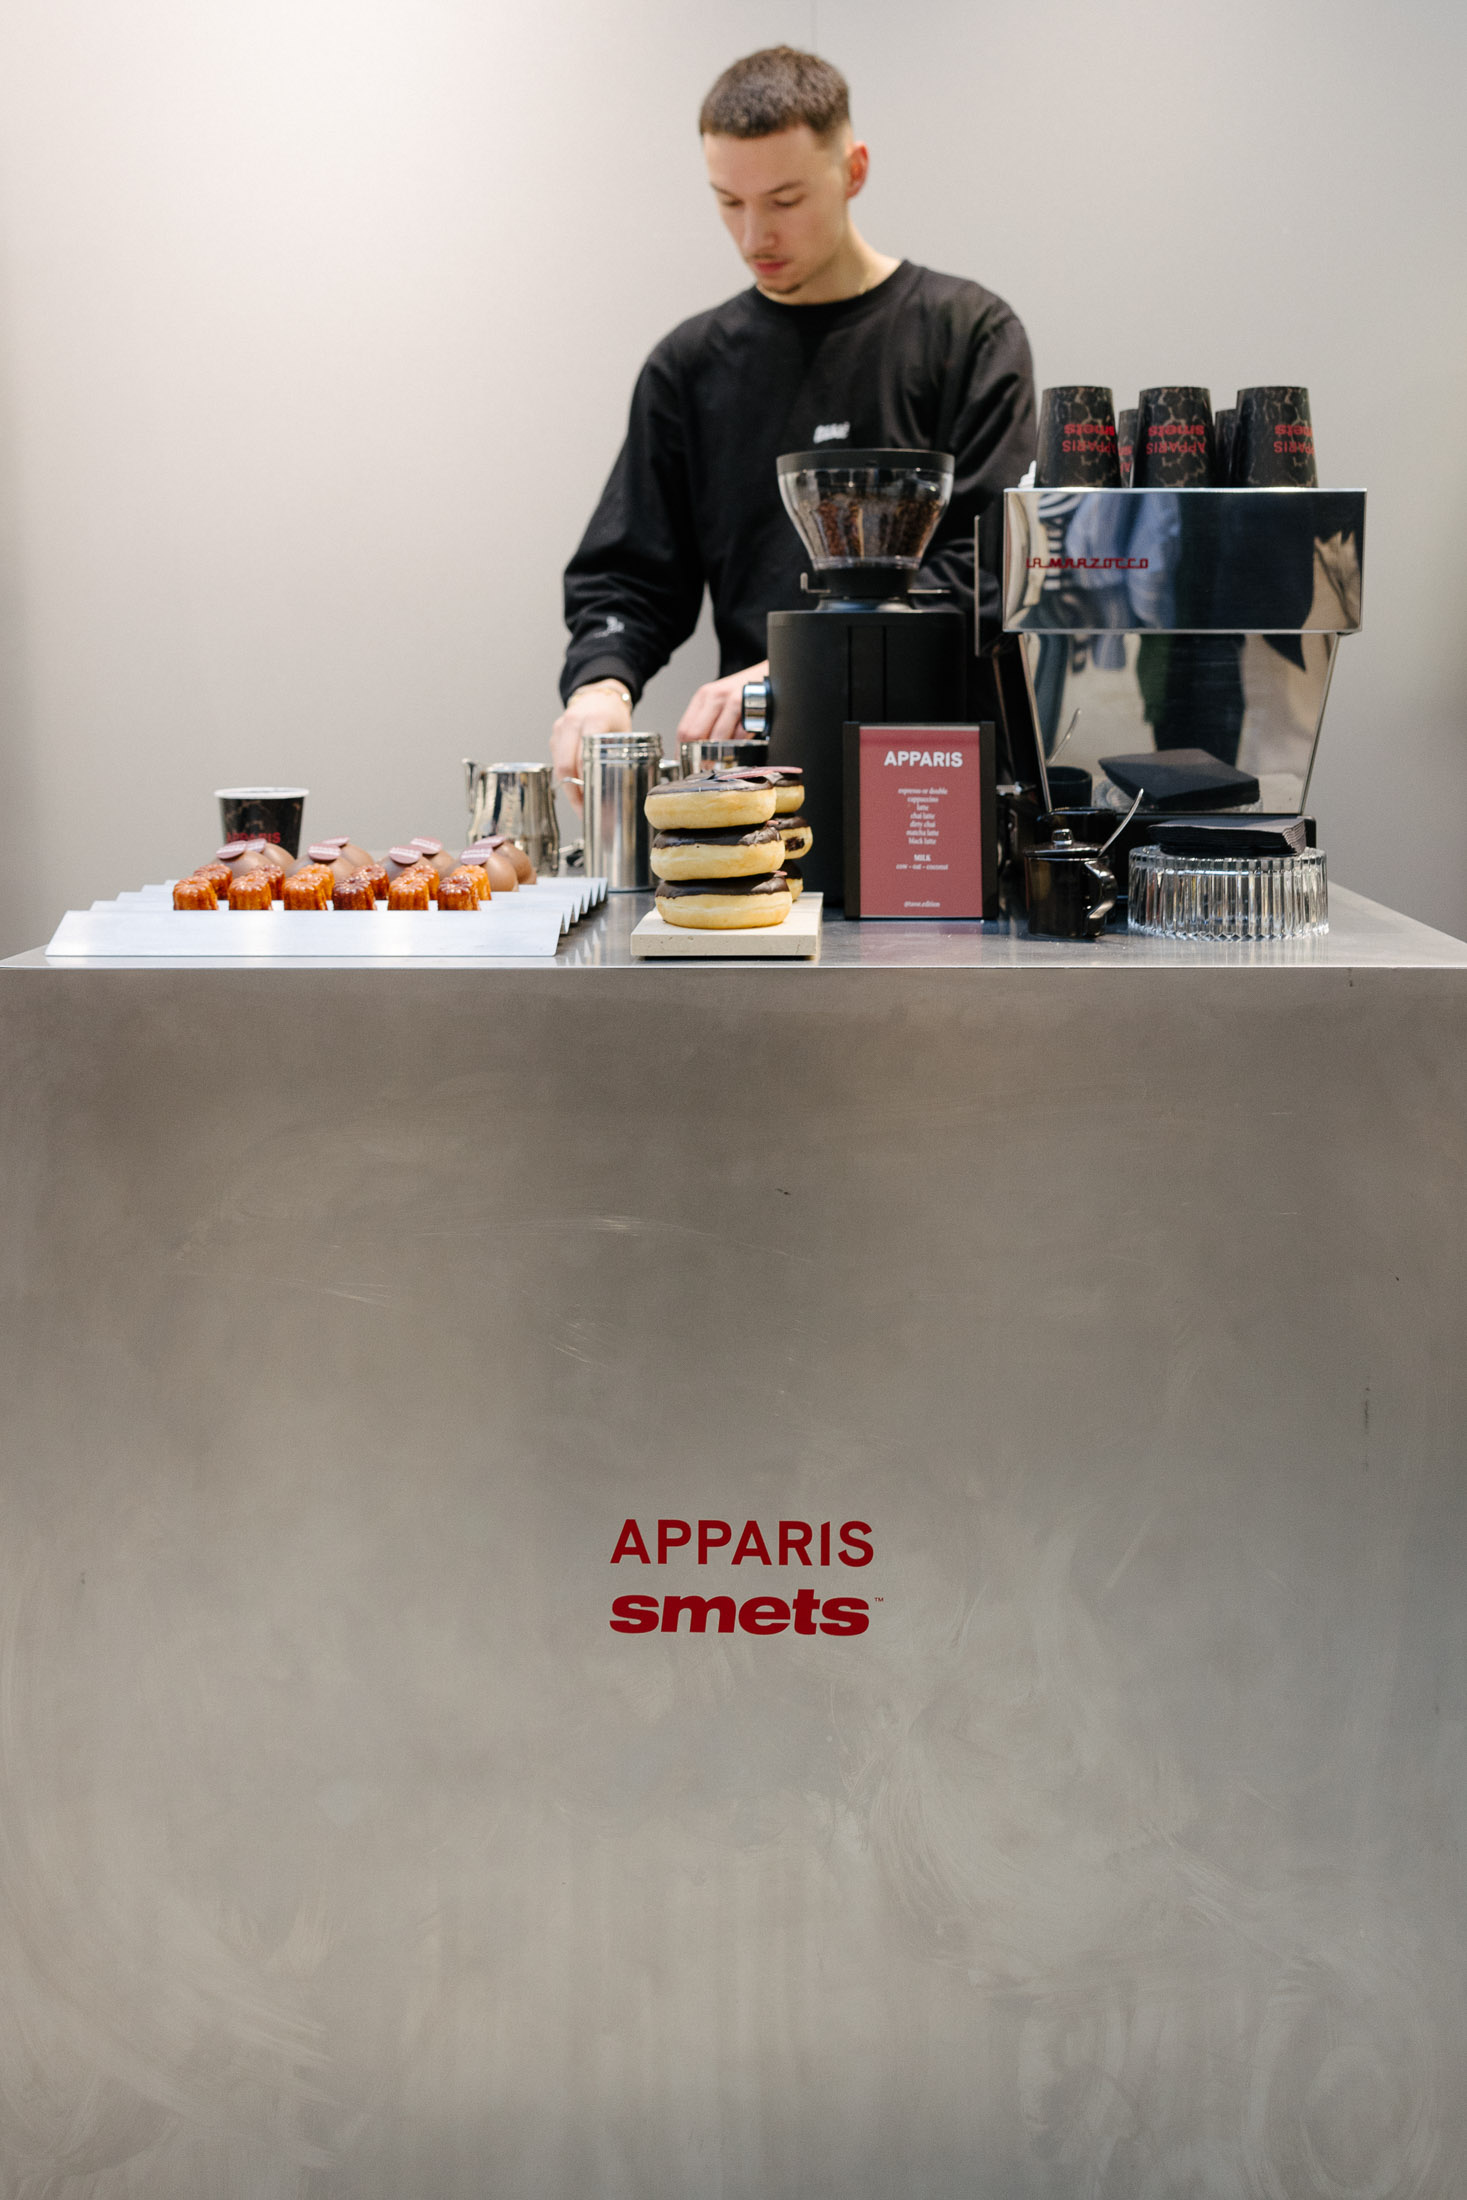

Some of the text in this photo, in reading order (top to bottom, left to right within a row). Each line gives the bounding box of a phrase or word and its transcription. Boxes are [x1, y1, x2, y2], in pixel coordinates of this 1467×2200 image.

[1148, 424, 1205, 437] smets
[1146, 440, 1206, 455] APPARIS
[1048, 557, 1149, 569] MARZOCCO
[884, 750, 963, 768] APPARIS
[914, 854, 931, 862] MILK
[610, 1519, 874, 1567] APPARIS
[609, 1589, 870, 1636] smets
